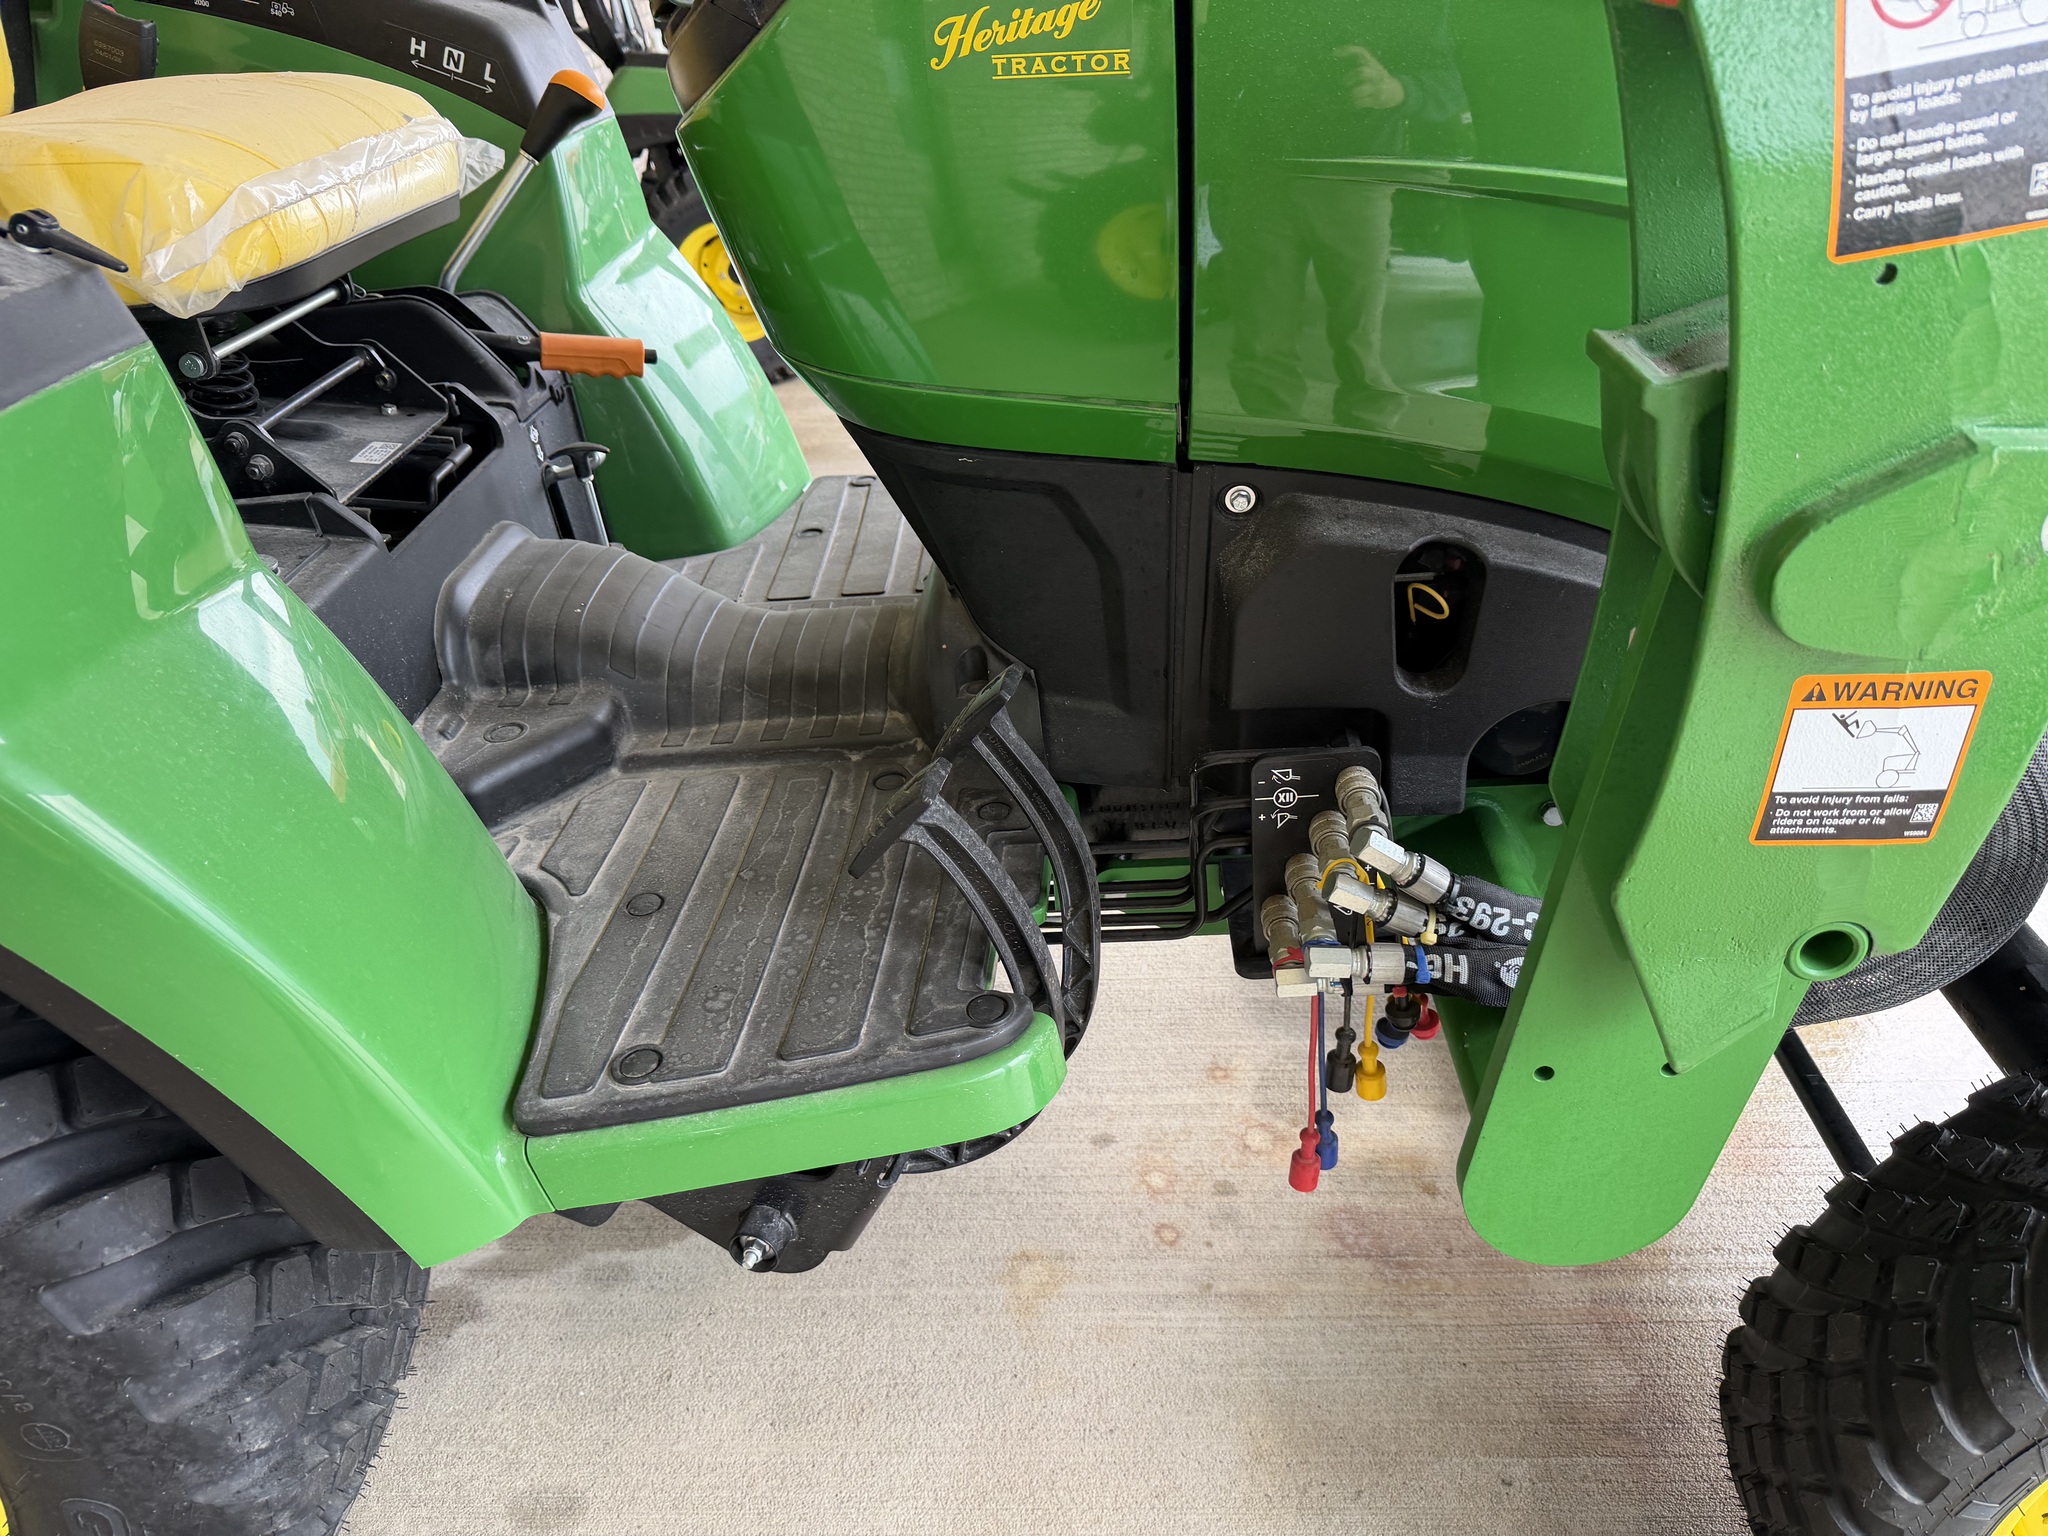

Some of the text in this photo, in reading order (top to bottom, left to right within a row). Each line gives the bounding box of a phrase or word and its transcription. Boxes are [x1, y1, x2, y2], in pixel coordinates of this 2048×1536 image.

[270, 8, 282, 17] 540
[930, 0, 1101, 71] Heritage
[410, 36, 496, 84] H N L
[992, 53, 1130, 75] TRACTOR
[1850, 93, 1870, 108] To
[1871, 83, 1912, 105] avoid
[1913, 77, 1955, 97] injury
[1956, 74, 1973, 88] or
[1974, 64, 2016, 84] death
[1850, 91, 1962, 125] by falling loads:
[1857, 111, 2018, 152] Do not handle round or
[1856, 132, 1988, 167] large square bales.
[1855, 144, 2025, 188] Handle raised loads with
[1854, 183, 1911, 203] caution.
[1853, 191, 1964, 221] Carry loads low.
[1834, 679, 1979, 702] WARNING
[1278, 792, 1294, 803] XII
[1774, 794, 1909, 806] To avoid injury from falls:
[1772, 817, 1803, 826] riders
[1822, 816, 1857, 825] loader
[1872, 816, 1886, 825] its
[1775, 808, 1790, 817] Do
[1793, 808, 1811, 817] not
[1813, 808, 1840, 817] work
[1842, 808, 1867, 816] from
[1883, 807, 1912, 816] allow
[1769, 826, 1837, 834] attachments.
